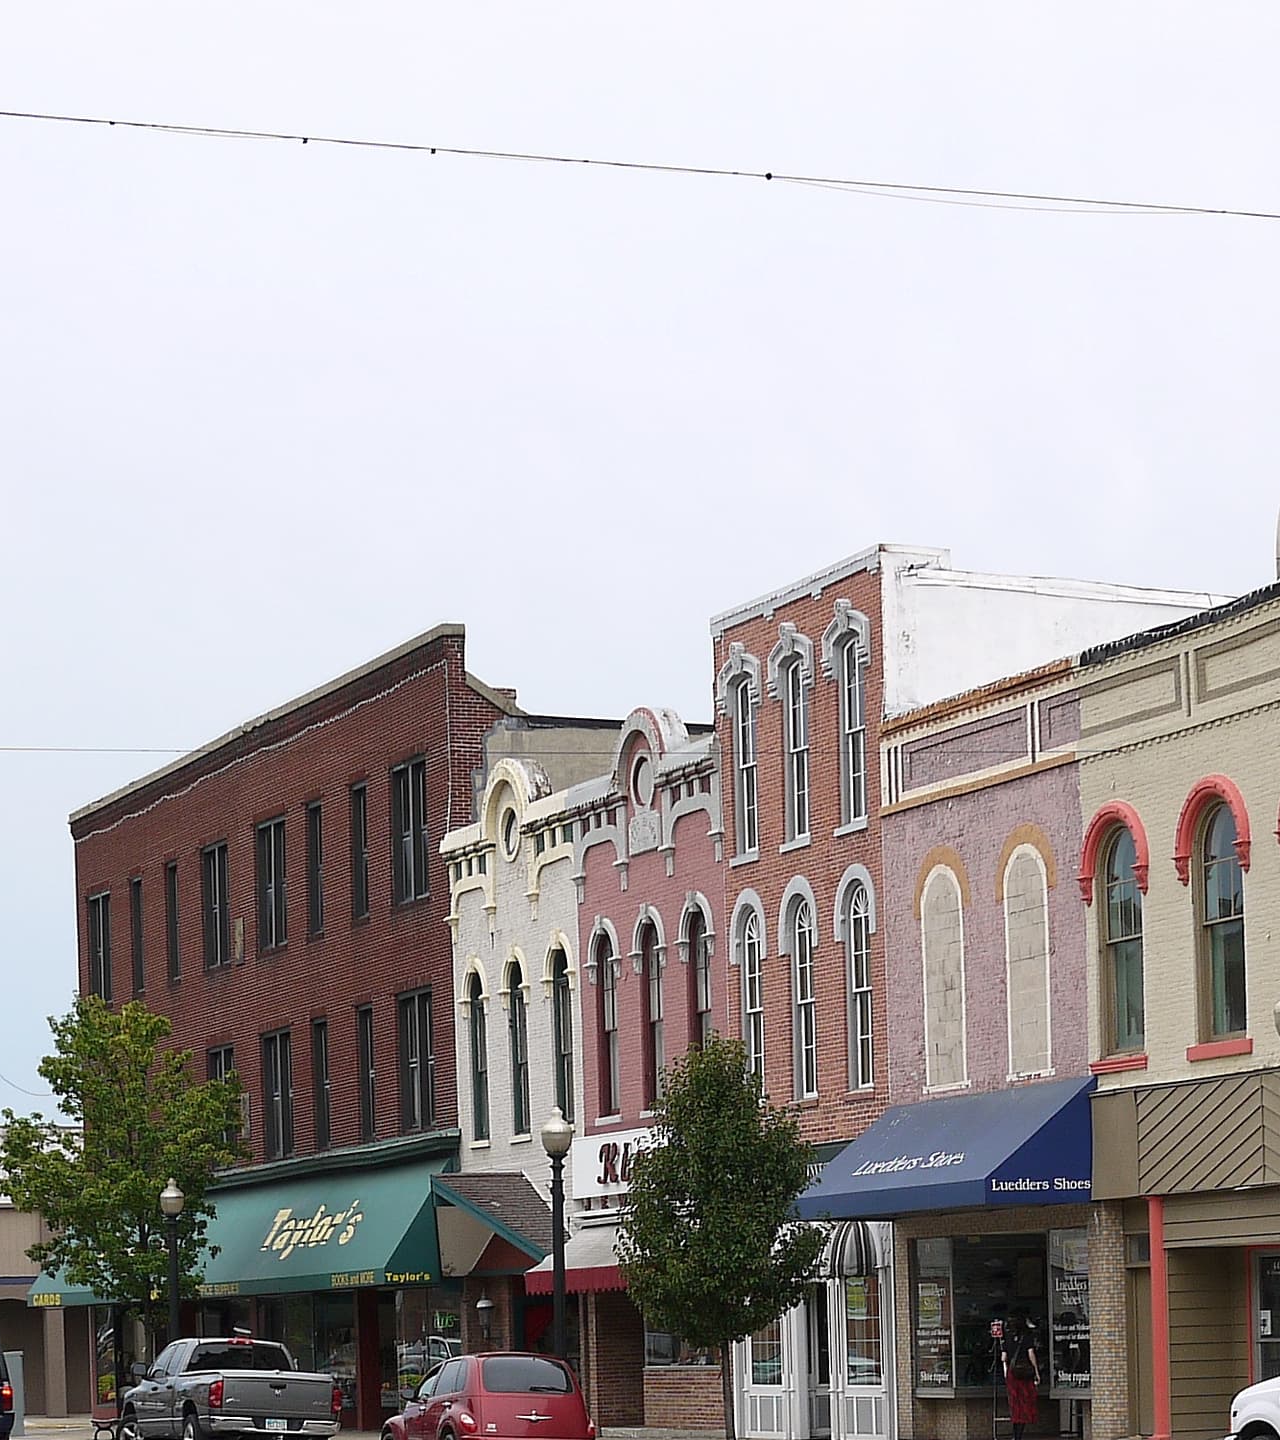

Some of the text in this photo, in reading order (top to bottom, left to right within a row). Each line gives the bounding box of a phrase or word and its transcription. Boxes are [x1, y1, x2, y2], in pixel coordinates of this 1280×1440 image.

[991, 1177, 1091, 1192] Luedders Shoes
[259, 1199, 364, 1260] Taylor's
[384, 1271, 431, 1284] Taylor's
[32, 1293, 61, 1307] CARDS
